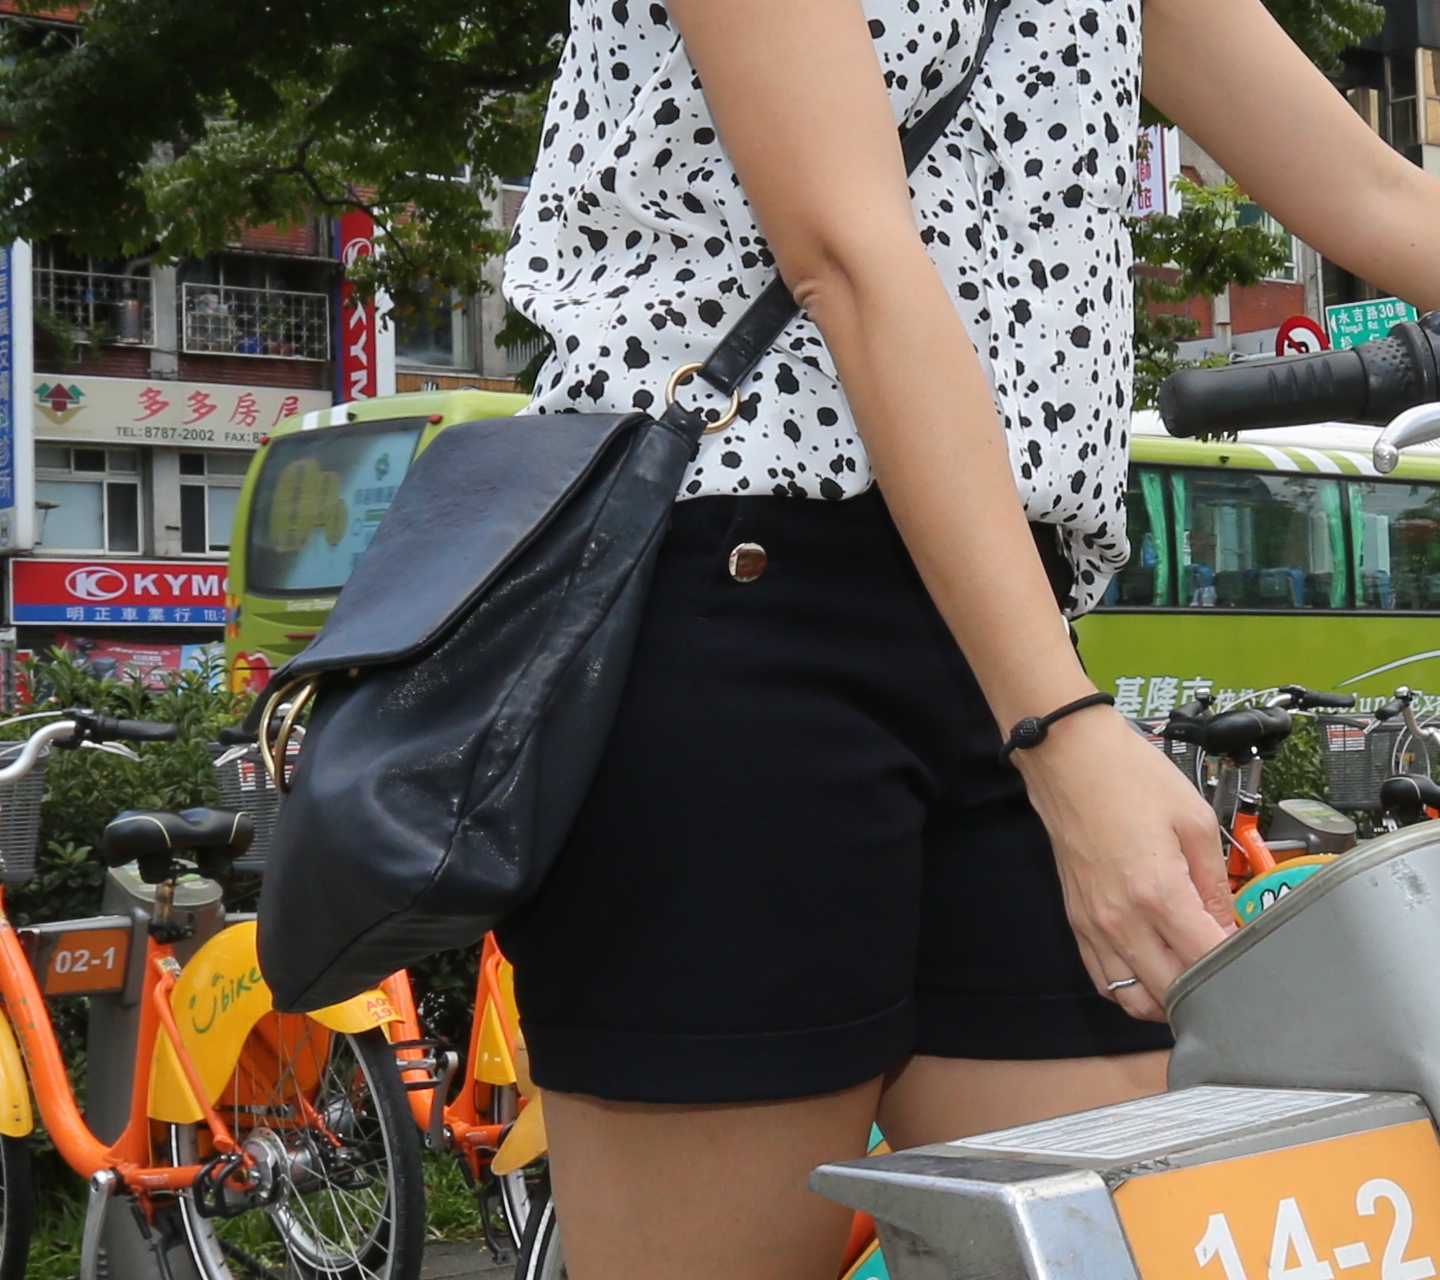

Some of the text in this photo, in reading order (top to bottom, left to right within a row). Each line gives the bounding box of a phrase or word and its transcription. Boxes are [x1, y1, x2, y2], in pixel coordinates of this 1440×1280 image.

[116, 426, 215, 442] TEL:8787-2002
[66, 606, 193, 623] 明正車業行
[54, 946, 116, 974] 02-1
